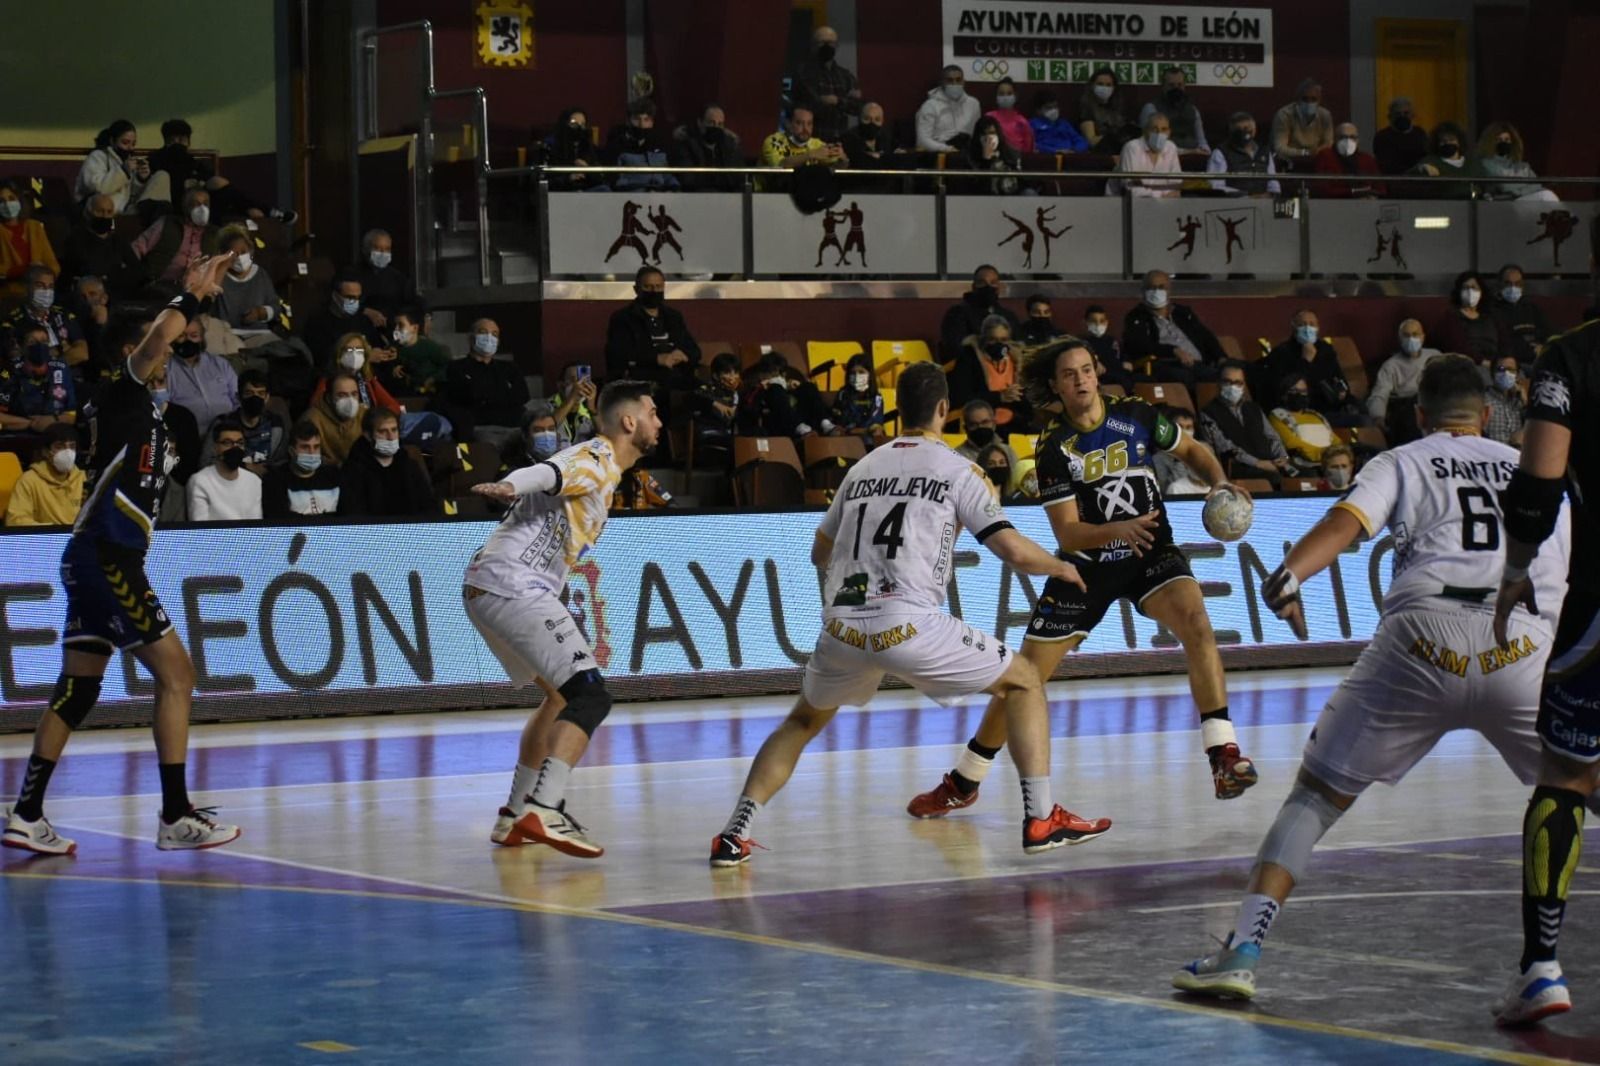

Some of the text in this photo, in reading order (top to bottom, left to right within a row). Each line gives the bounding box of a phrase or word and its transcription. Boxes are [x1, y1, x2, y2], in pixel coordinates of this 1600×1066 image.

[958, 10, 1260, 39] AYUNTAMIENTO DE LEÓN
[1114, 44, 1136, 57] DE
[1082, 440, 1129, 484] 66
[1430, 457, 1519, 483] SANTIS
[844, 476, 950, 504] LOSAVLJEVIĆ
[852, 502, 908, 560] 14
[1457, 486, 1500, 551] 6
[869, 622, 919, 653] ERKA
[1551, 719, 1600, 748] Cajas
